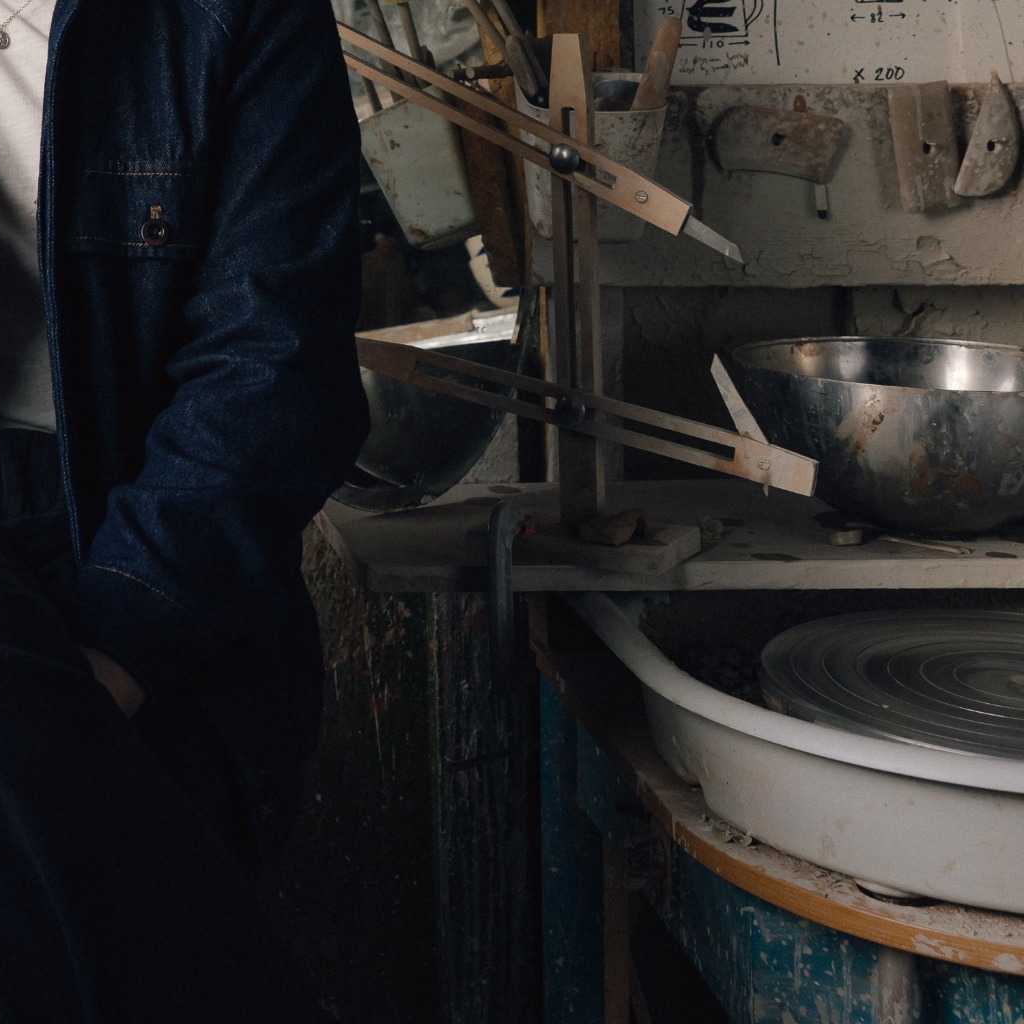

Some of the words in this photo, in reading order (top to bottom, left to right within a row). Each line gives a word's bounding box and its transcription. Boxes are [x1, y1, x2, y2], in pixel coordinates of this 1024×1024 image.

[658, 6, 675, 15] 75
[870, 11, 884, 23] 82
[702, 41, 724, 49] 110
[875, 67, 905, 81] 200
